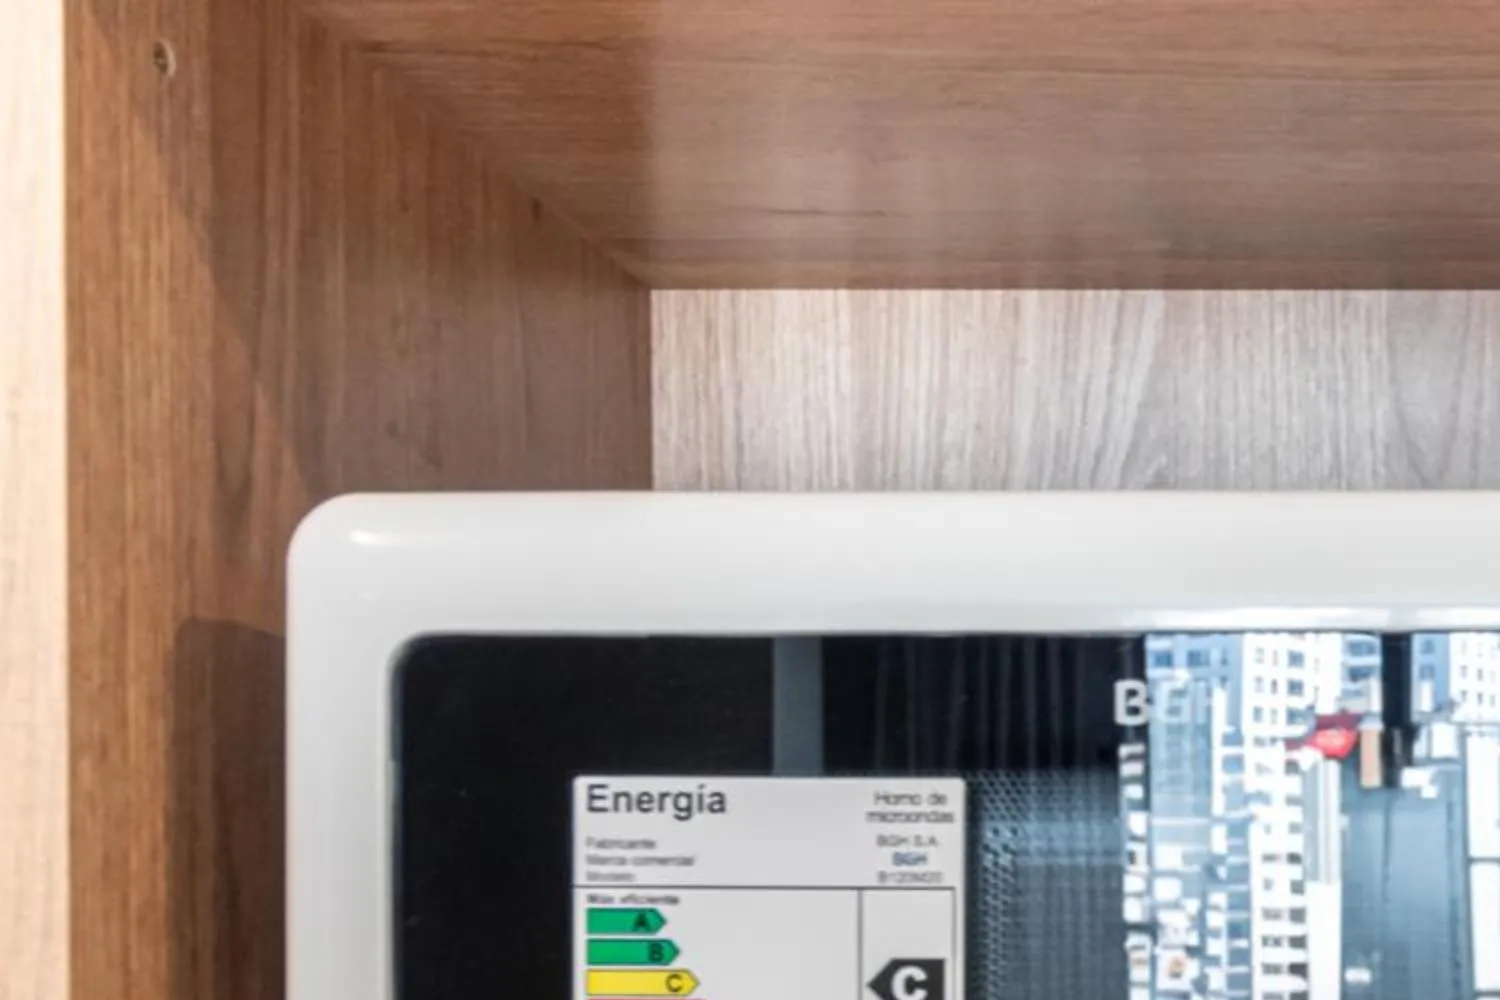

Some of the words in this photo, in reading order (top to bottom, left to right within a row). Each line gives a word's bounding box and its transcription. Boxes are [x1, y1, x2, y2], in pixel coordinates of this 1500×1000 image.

[633, 913, 649, 931] A
[648, 944, 664, 962] B
[664, 974, 684, 993] C
